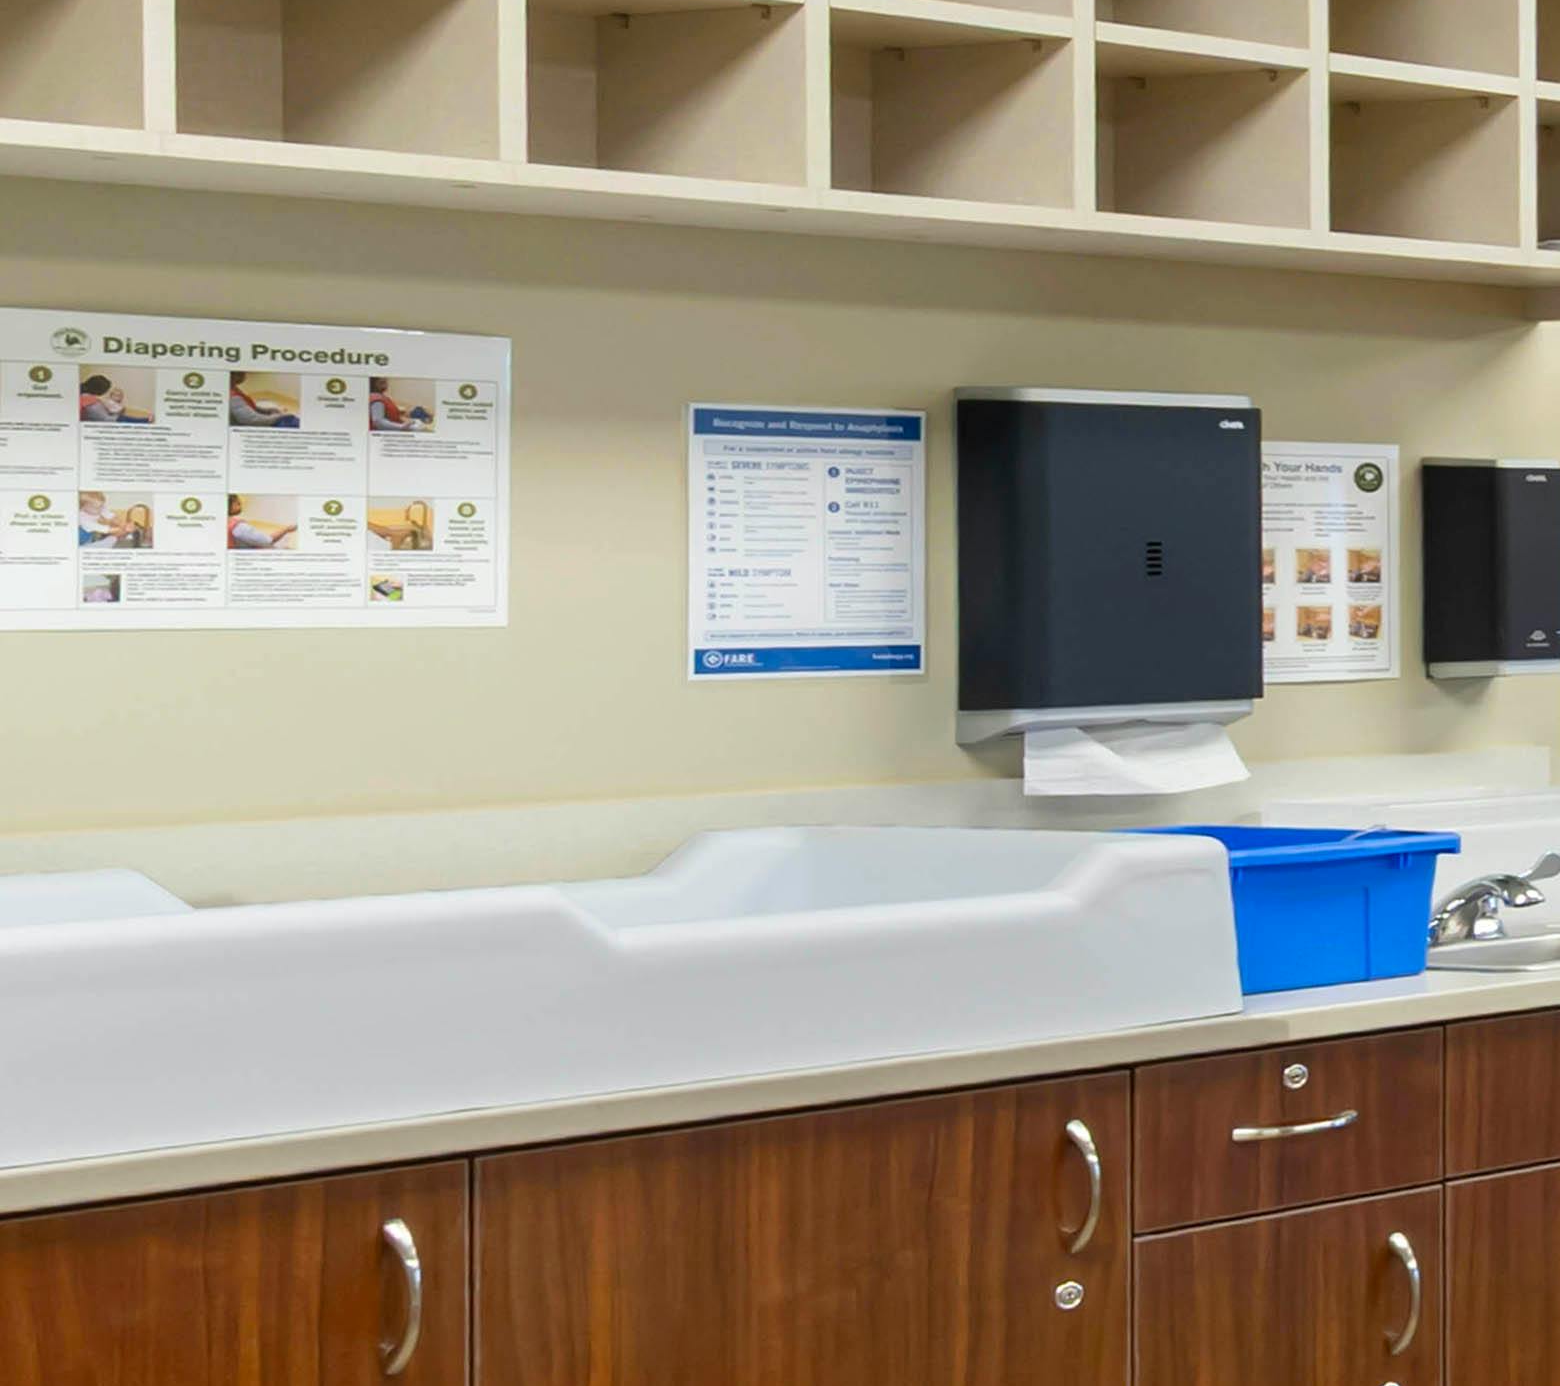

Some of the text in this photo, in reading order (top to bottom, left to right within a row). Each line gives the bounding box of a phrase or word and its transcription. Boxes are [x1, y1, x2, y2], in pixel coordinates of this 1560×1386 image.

[102, 336, 390, 366] Diapering Procedure
[1274, 462, 1302, 472] Your
[1305, 463, 1343, 473] Hands
